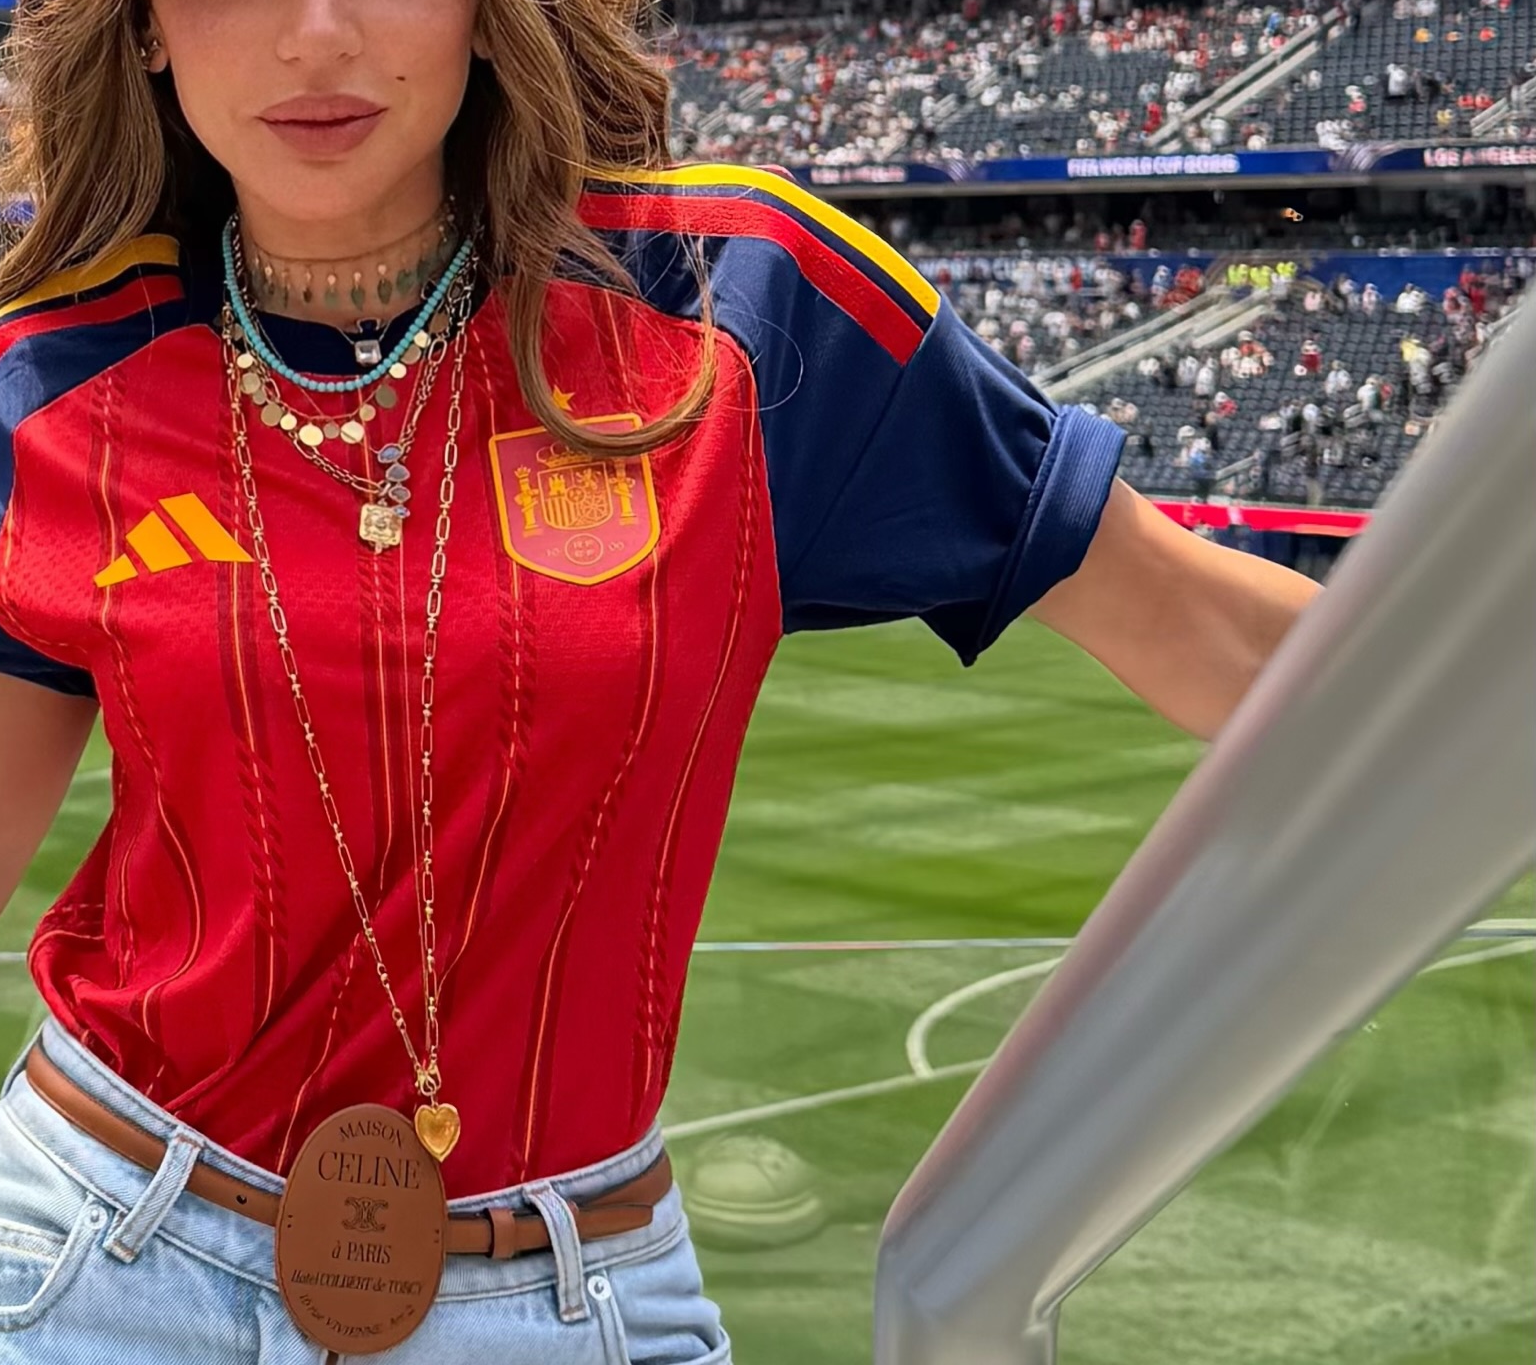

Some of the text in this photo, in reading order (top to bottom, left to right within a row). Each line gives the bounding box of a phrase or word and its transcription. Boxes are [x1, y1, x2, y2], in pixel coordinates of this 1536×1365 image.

[339, 1120, 403, 1150] MAISON
[318, 1151, 420, 1189] CELINE
[332, 1240, 392, 1264] à PARIS
